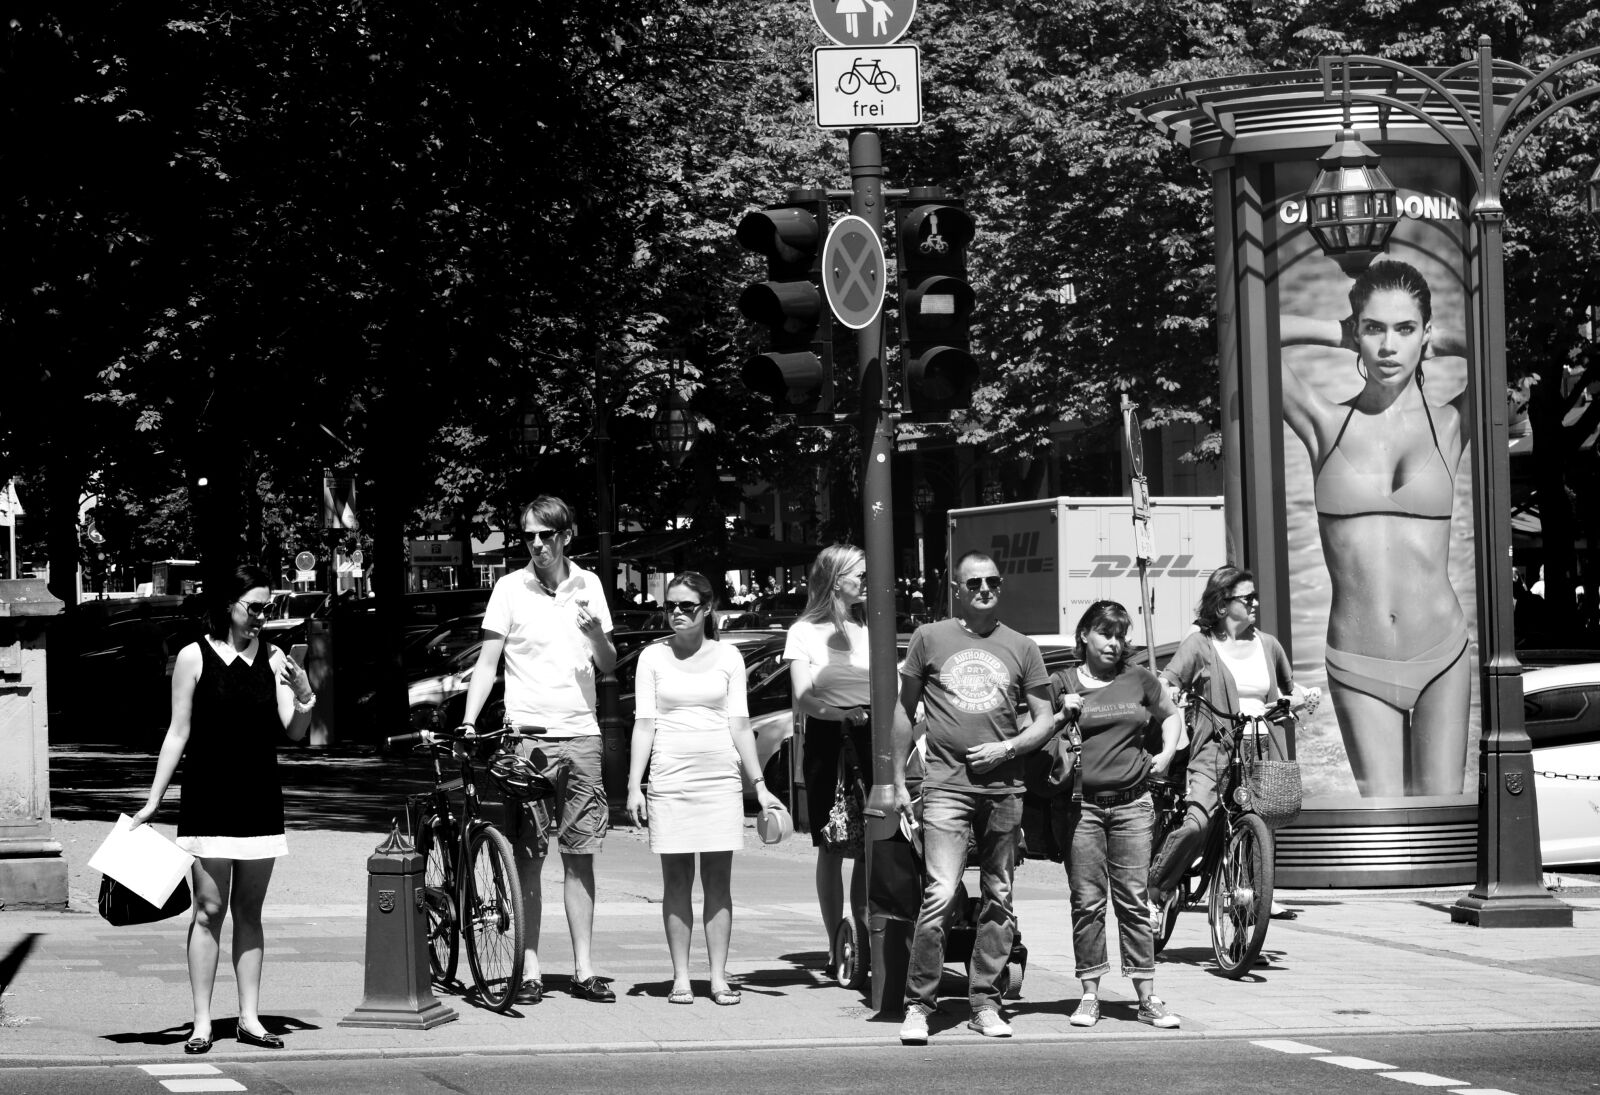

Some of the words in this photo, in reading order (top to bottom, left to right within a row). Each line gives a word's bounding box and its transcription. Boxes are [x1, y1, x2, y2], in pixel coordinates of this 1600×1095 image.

[853, 99, 884, 117] frei
[991, 531, 1044, 575] DHL
[1089, 554, 1200, 578] DHL
[954, 651, 1000, 668] AUTHORIZED
